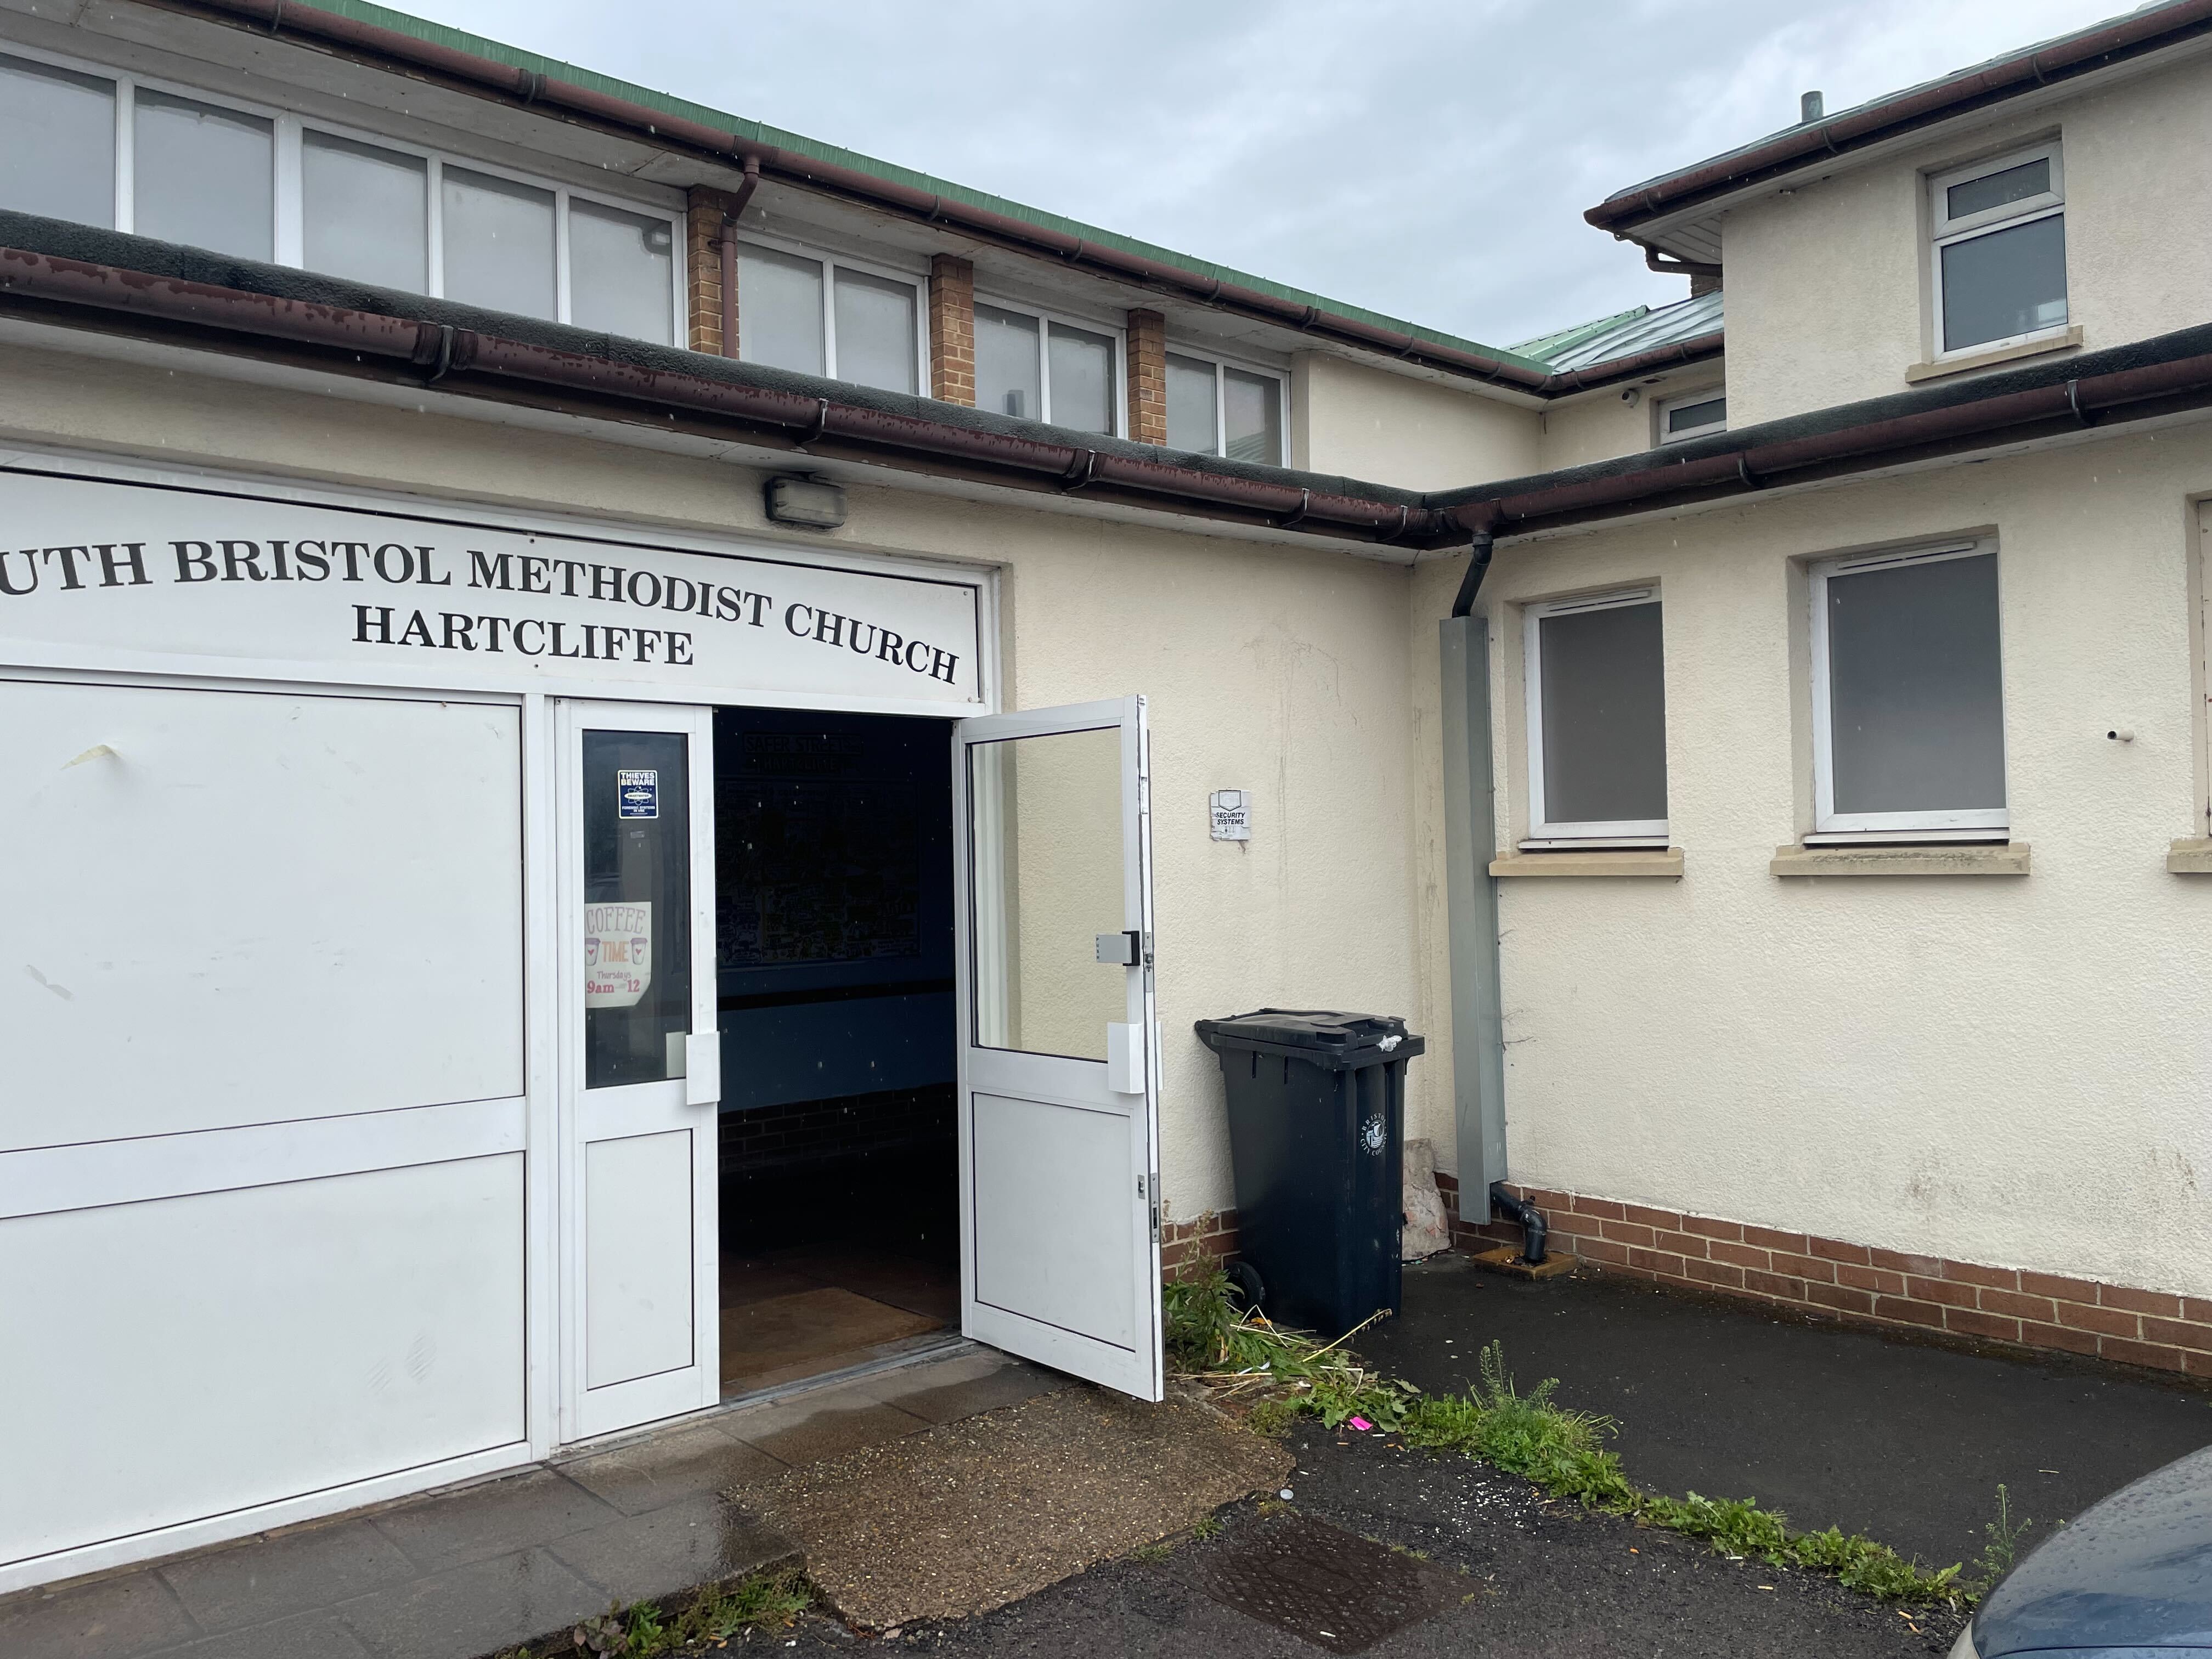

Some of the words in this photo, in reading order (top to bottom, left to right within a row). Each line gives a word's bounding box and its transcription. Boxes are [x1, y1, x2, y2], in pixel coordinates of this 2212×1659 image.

[0, 542, 154, 595] UTH
[168, 539, 451, 585] BRISTOL
[466, 550, 772, 628] METHODIST
[785, 603, 960, 685] CHURCH
[351, 604, 694, 665] HARTCLIFFE
[586, 906, 646, 934] COFFEE
[601, 940, 630, 963] TIME
[586, 980, 615, 994] 9am
[627, 979, 640, 992] 12
[596, 970, 632, 981] Thursdays
[1361, 1113, 1386, 1131] BRISTOL
[1360, 1138, 1370, 1154] CITY
[1372, 1132, 1387, 1156] COUNCIL
